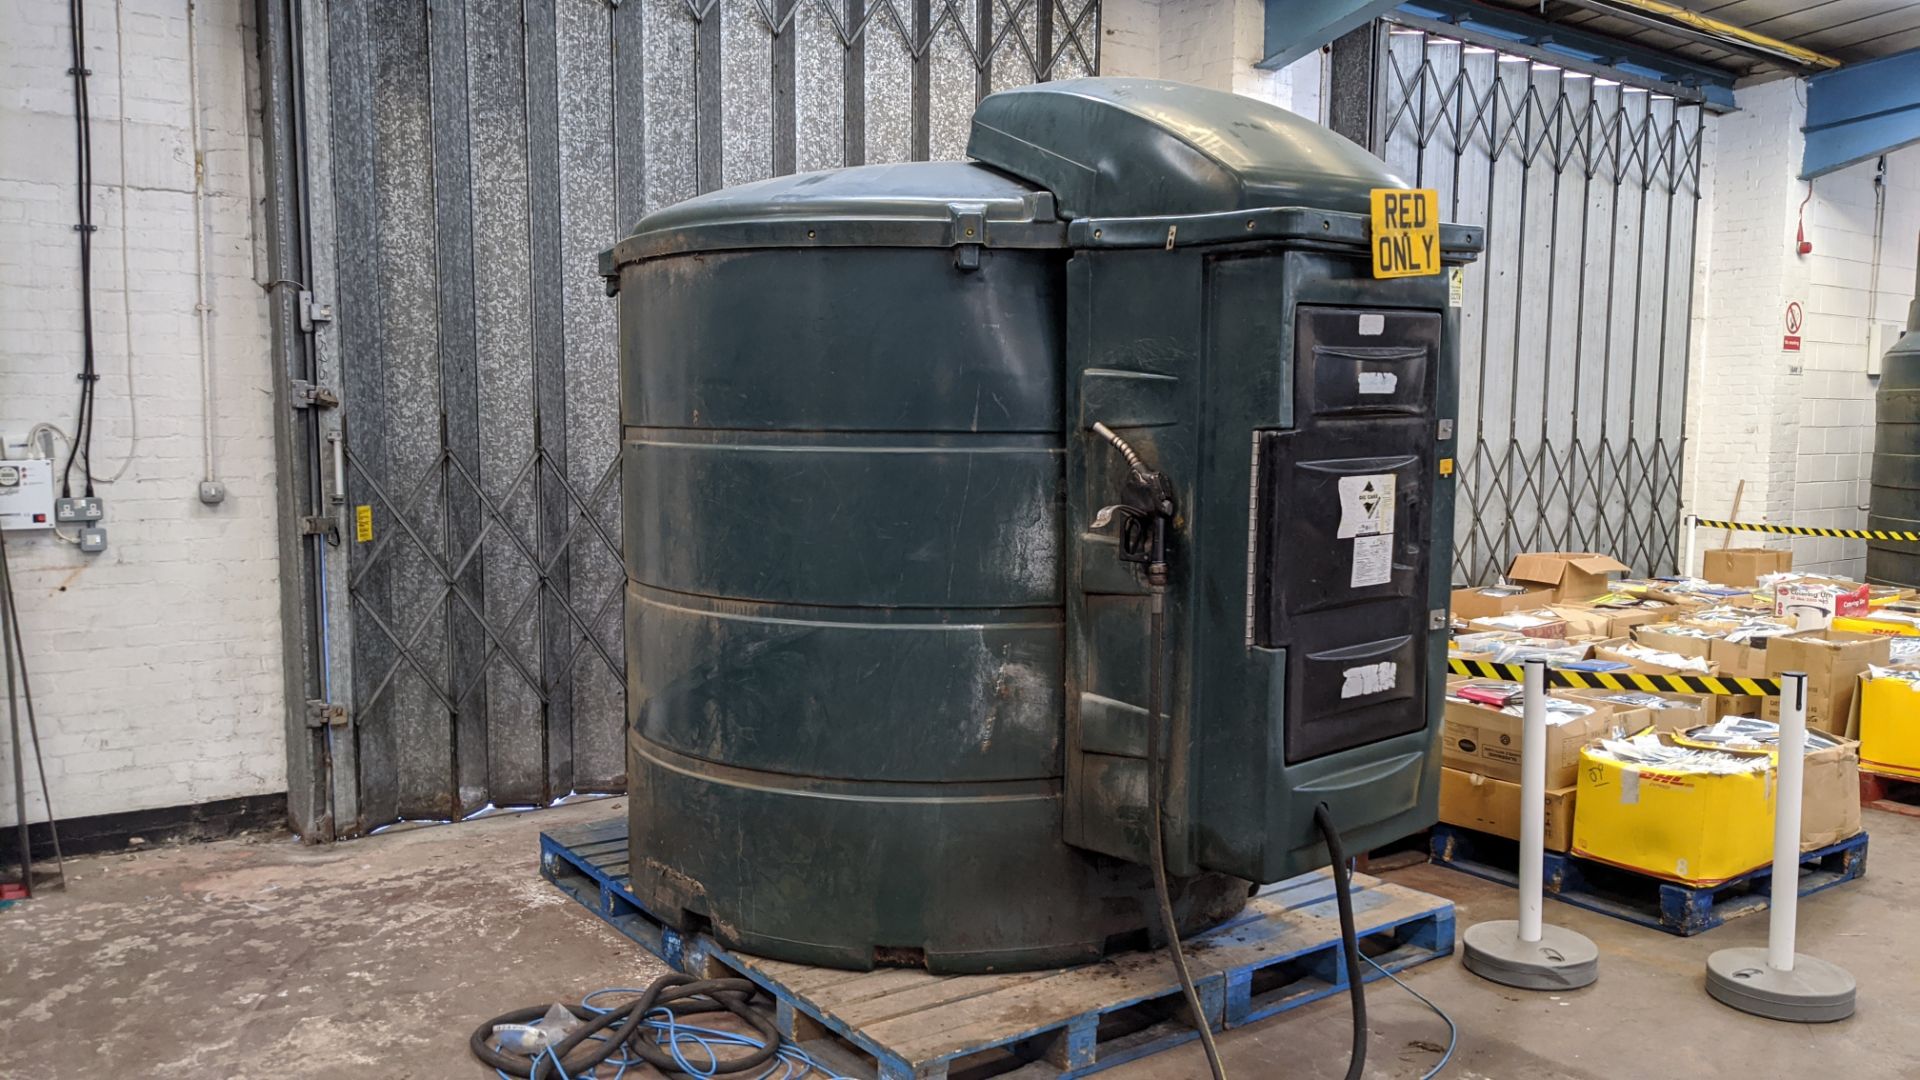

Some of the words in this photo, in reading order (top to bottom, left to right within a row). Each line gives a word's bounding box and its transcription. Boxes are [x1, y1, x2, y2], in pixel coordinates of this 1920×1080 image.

[1384, 193, 1426, 229] RED
[1380, 235, 1433, 271] ONLY
[1639, 770, 1684, 786] DHL
